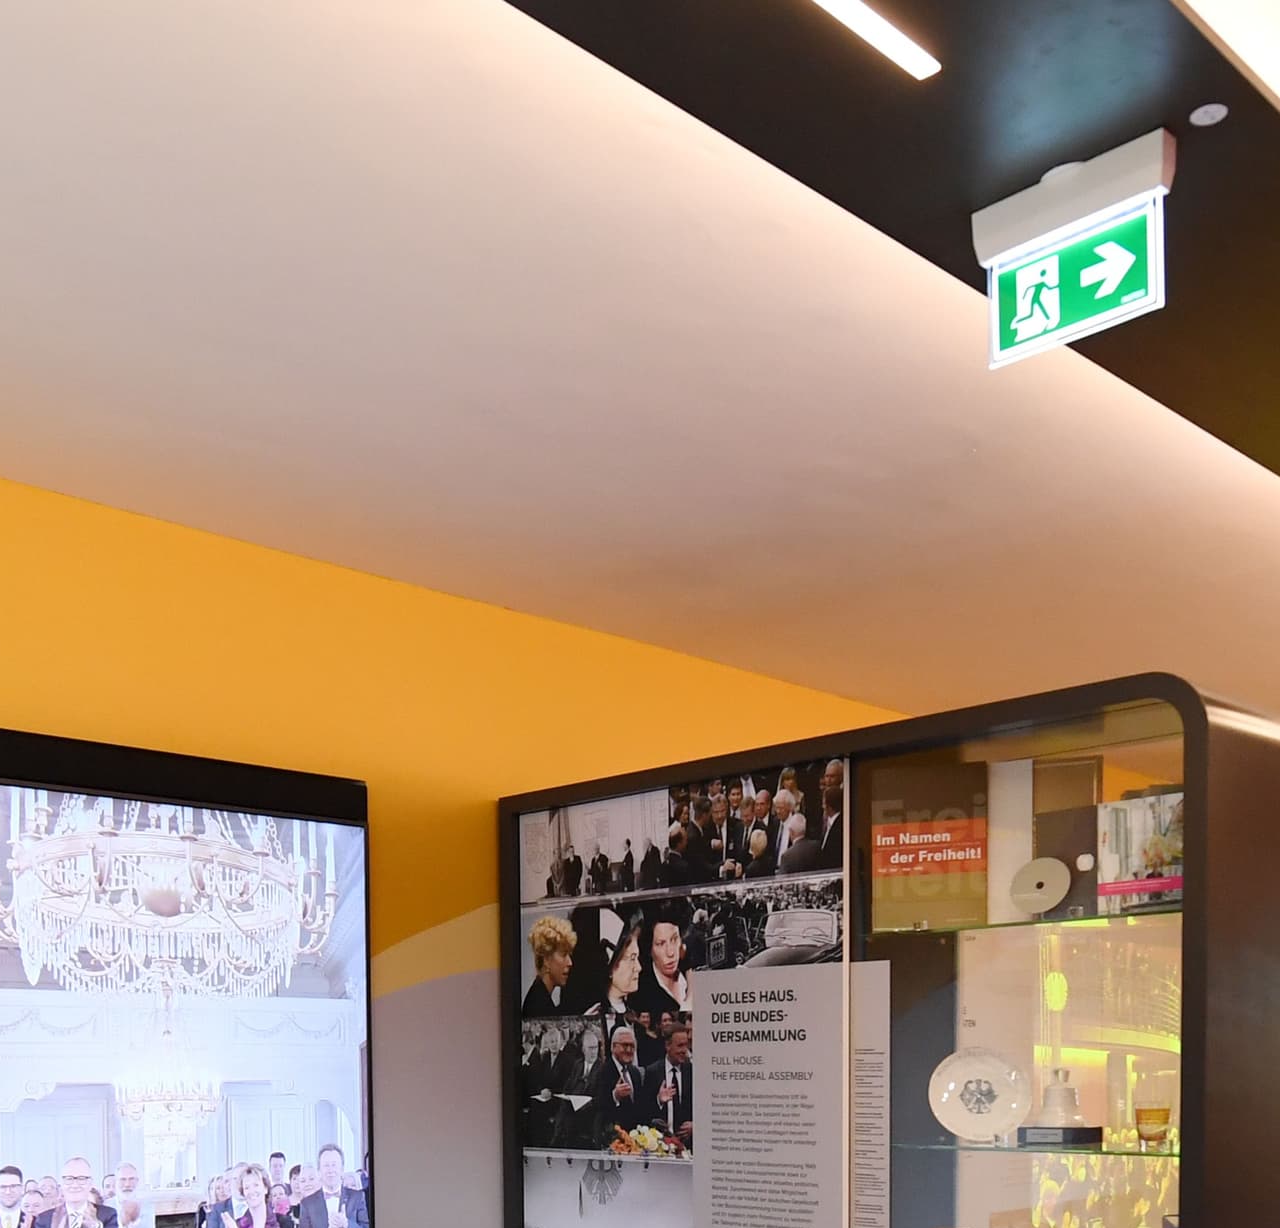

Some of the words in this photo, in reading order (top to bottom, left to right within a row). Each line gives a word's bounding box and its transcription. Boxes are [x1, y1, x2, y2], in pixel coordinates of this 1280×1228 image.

[876, 834, 895, 846] Im
[899, 832, 951, 845] Namen
[890, 852, 915, 864] der
[918, 848, 982, 862] Freiheit!
[711, 991, 756, 1005] VOLLES
[759, 990, 797, 1002] HAUS.
[712, 1012, 730, 1024] DIE
[734, 1010, 788, 1023] BUNDES-
[711, 1029, 806, 1043] VERSAMMLUNG
[711, 1056, 731, 1065] FULL
[712, 1071, 727, 1080] THE
[729, 1072, 766, 1081] FEDERAL
[768, 1072, 813, 1081] ASSEMBLY
